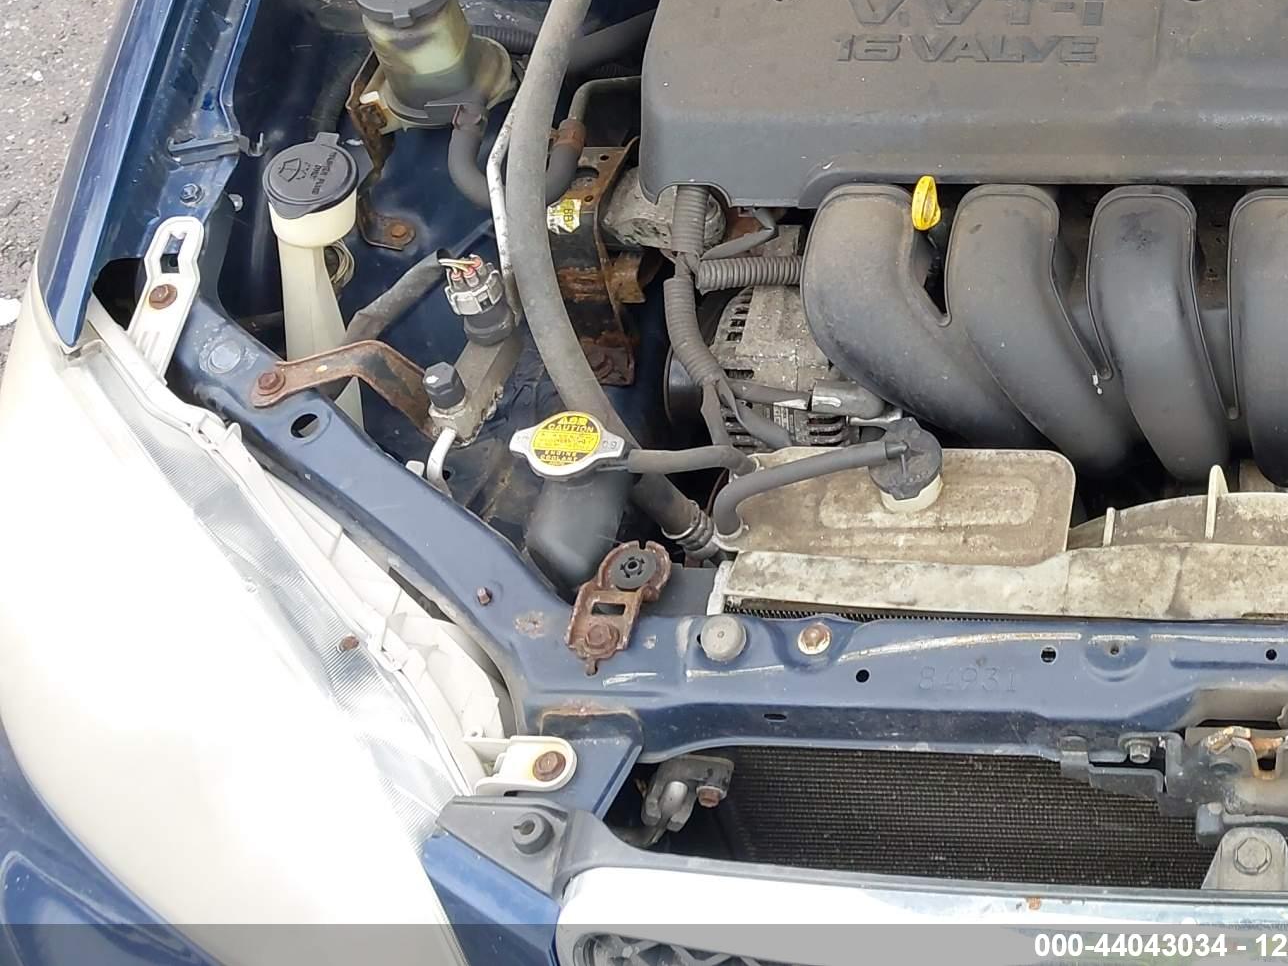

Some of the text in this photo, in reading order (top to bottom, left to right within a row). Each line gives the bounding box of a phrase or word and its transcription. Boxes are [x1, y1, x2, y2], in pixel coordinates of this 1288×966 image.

[832, 33, 1099, 63] 16 VALVE
[547, 423, 595, 433] CAUTION
